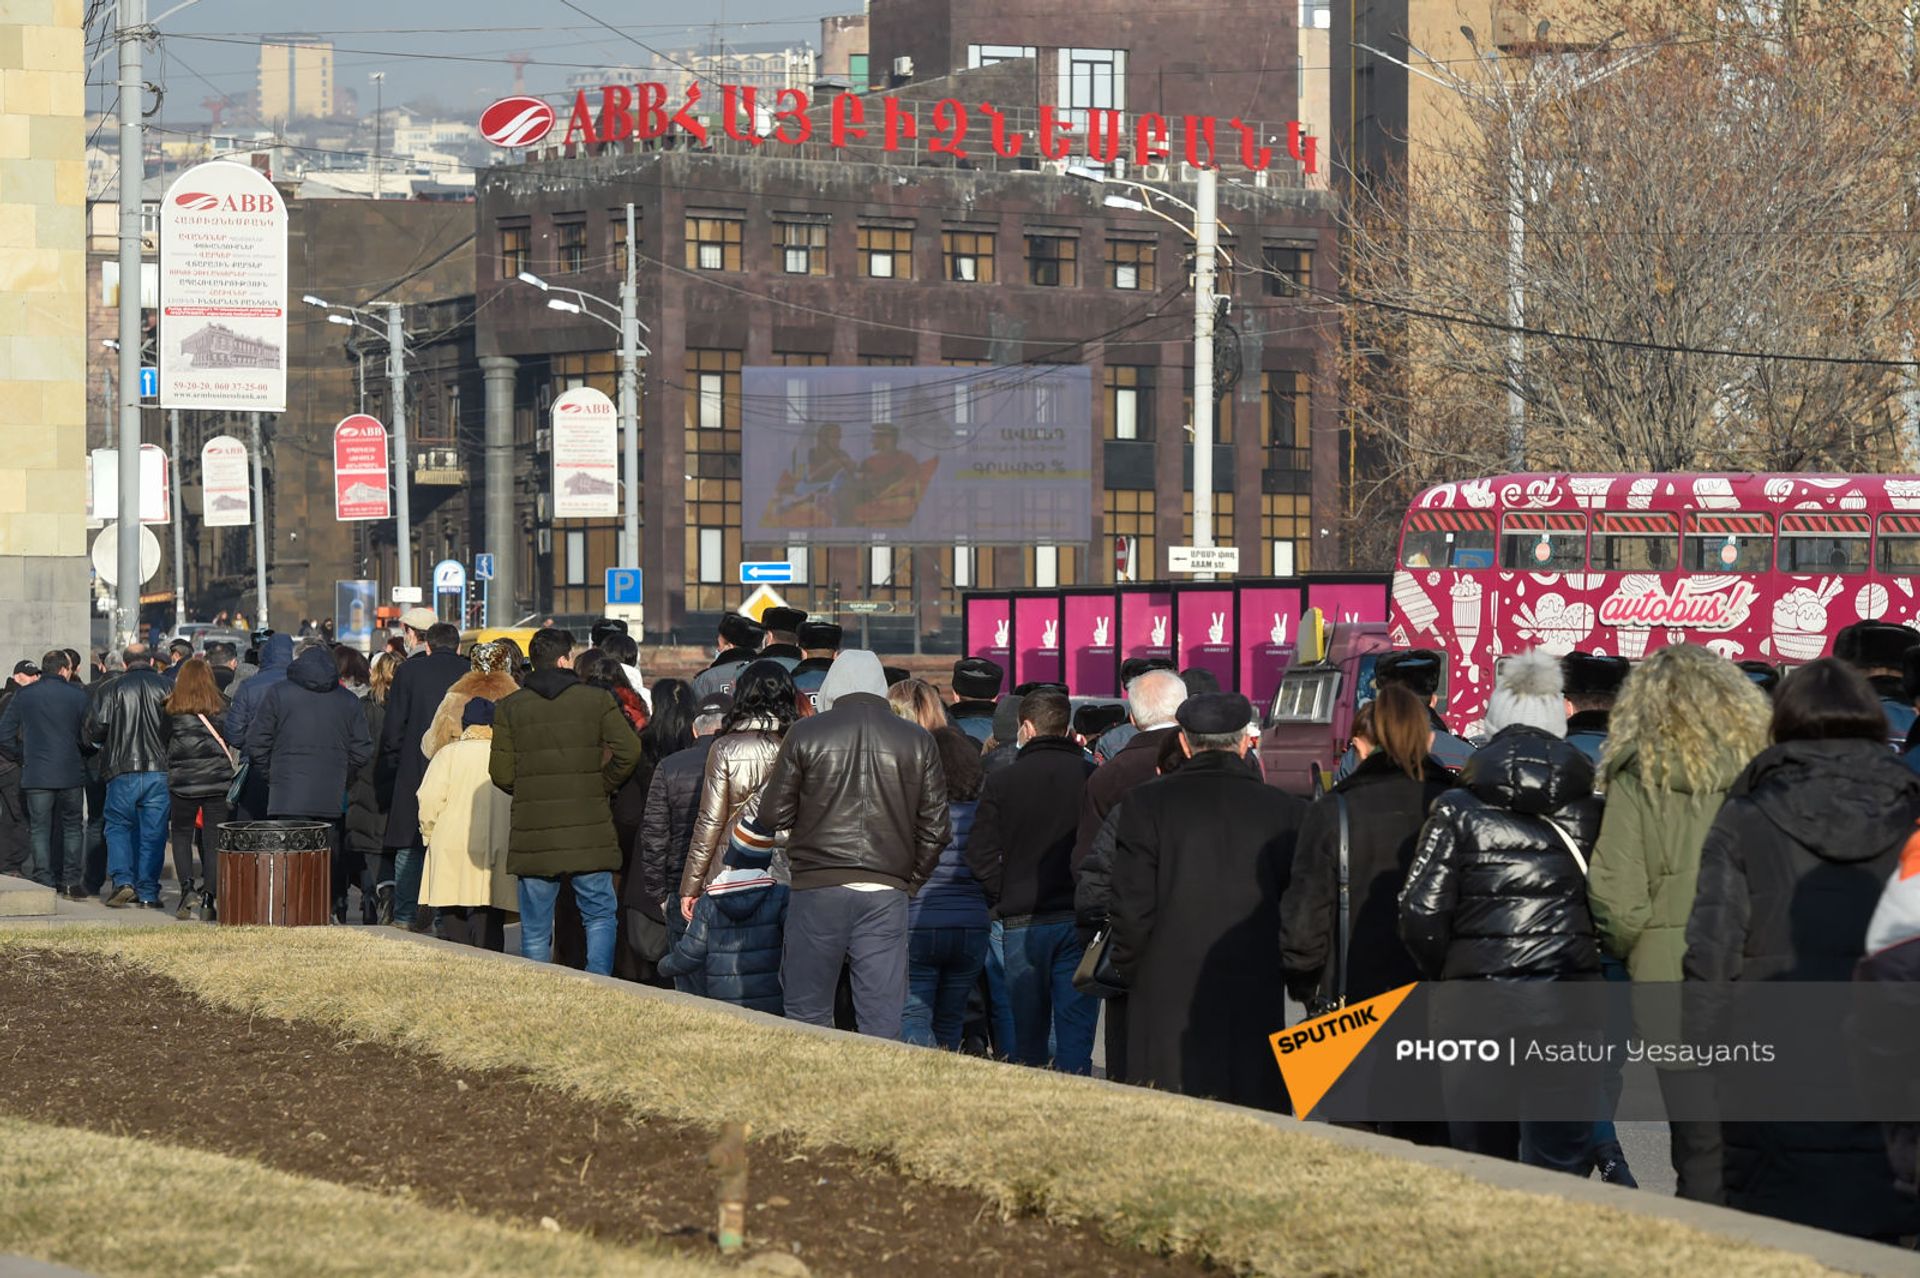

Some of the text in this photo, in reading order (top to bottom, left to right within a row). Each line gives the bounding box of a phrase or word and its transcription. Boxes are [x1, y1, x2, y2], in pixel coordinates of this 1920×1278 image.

[563, 81, 669, 145] ABB
[671, 80, 1319, 174] ՀԱՅԲԻԶՆԵՍԲԱՆԿ
[222, 194, 274, 213] ABB
[583, 404, 610, 414] ABB
[359, 427, 382, 437] ABB
[615, 571, 634, 601] P
[1601, 580, 1748, 625] autobus!
